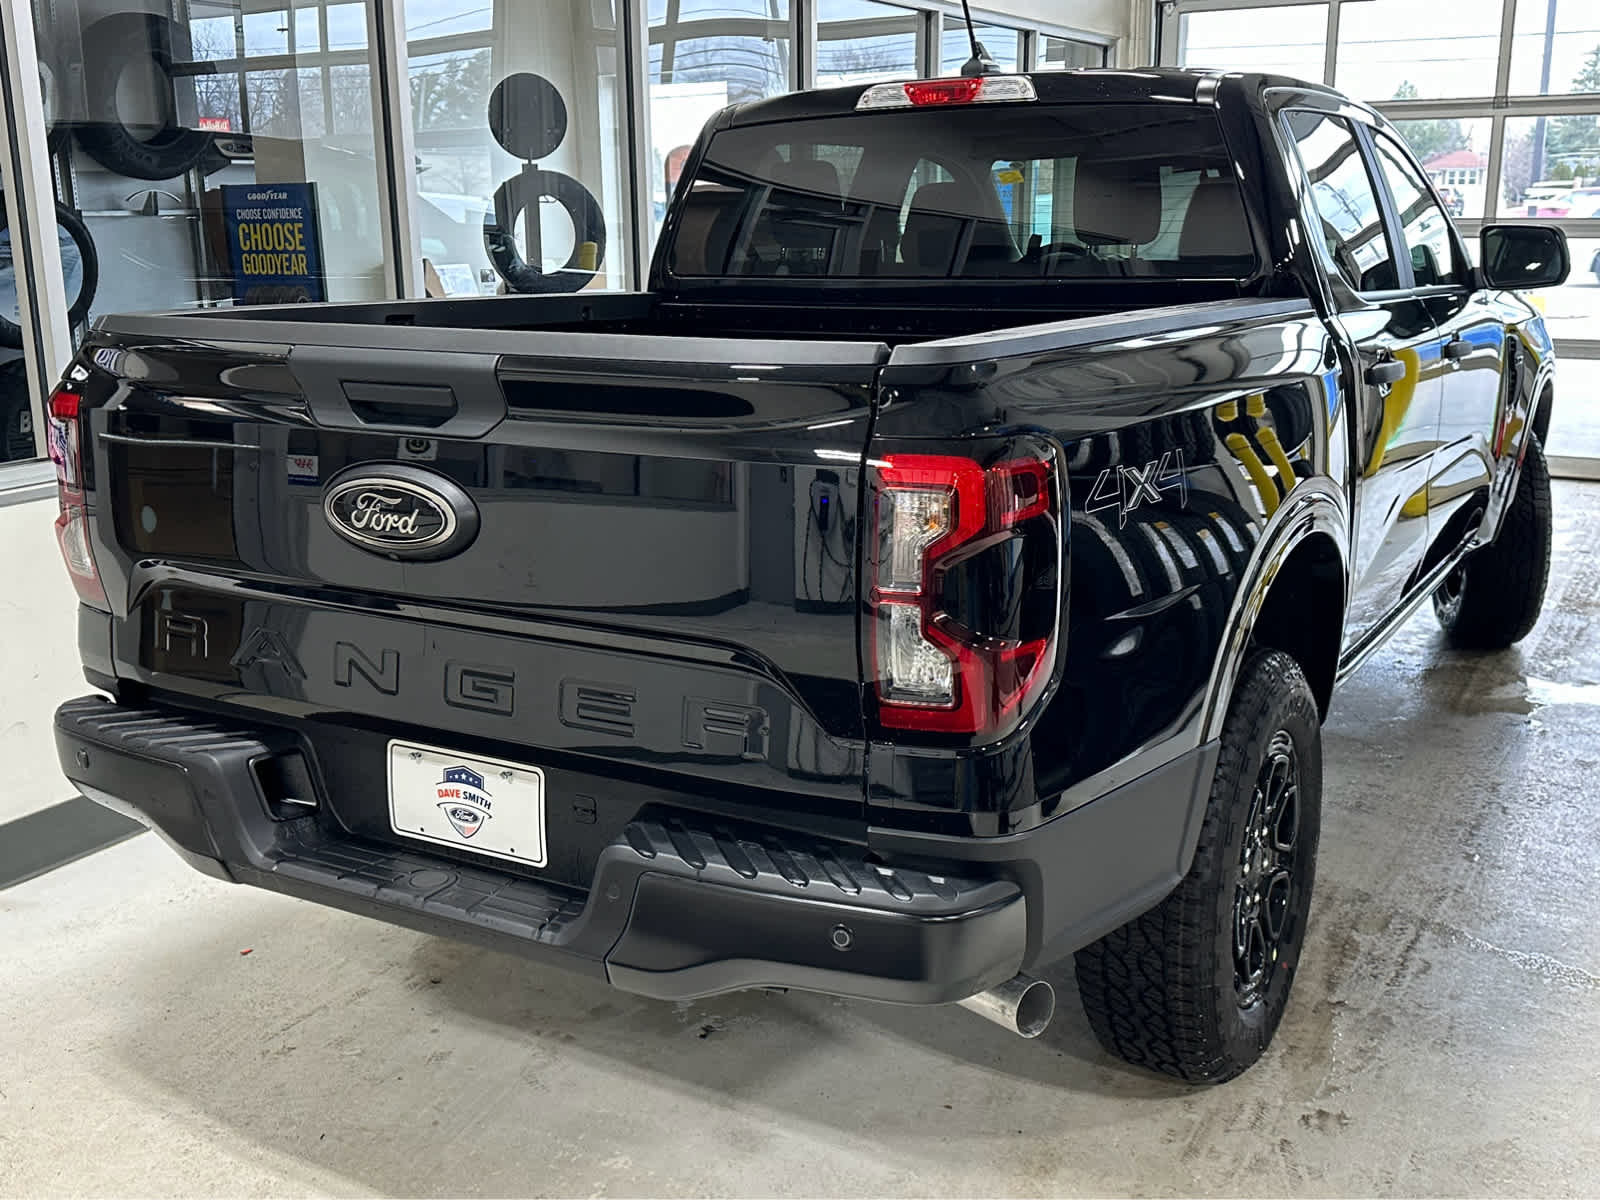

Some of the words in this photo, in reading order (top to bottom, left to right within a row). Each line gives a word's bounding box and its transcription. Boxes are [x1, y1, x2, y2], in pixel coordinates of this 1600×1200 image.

[247, 190, 288, 201] GOODYEAR
[236, 208, 262, 220] CHOOSE
[262, 207, 303, 220] CONFIDENCE
[238, 222, 306, 251] CHOOSE
[242, 253, 308, 275] GOODYEAR
[351, 492, 420, 535] Ford
[153, 607, 771, 763] RANGER
[437, 788, 461, 799] DAVE
[462, 791, 492, 810] SMITH
